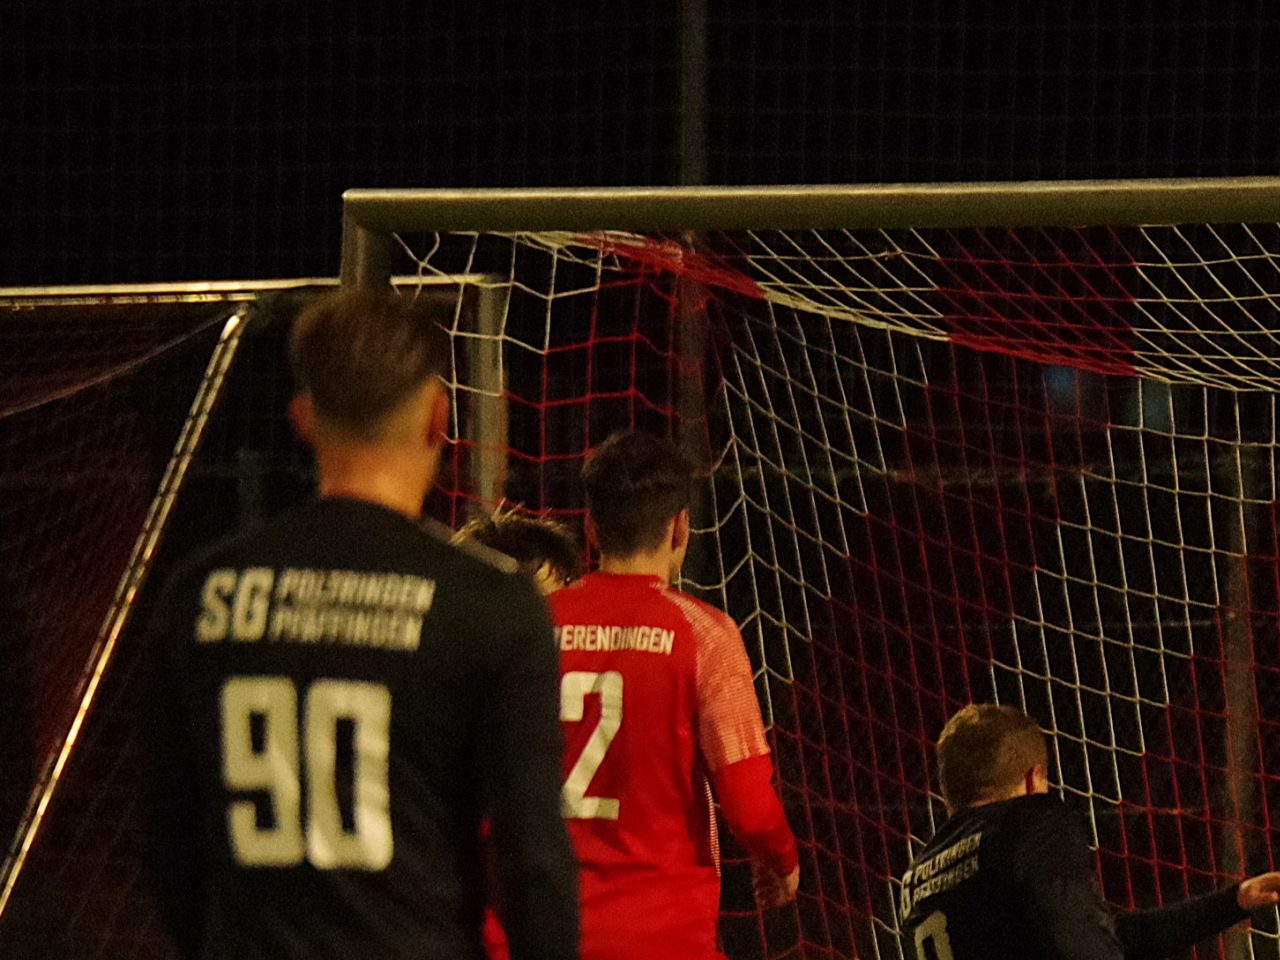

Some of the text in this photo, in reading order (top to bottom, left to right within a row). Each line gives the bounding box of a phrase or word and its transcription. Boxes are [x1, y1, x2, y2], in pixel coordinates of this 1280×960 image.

[196, 567, 275, 643] SG
[220, 675, 394, 871] 90
[559, 670, 623, 821] 2
